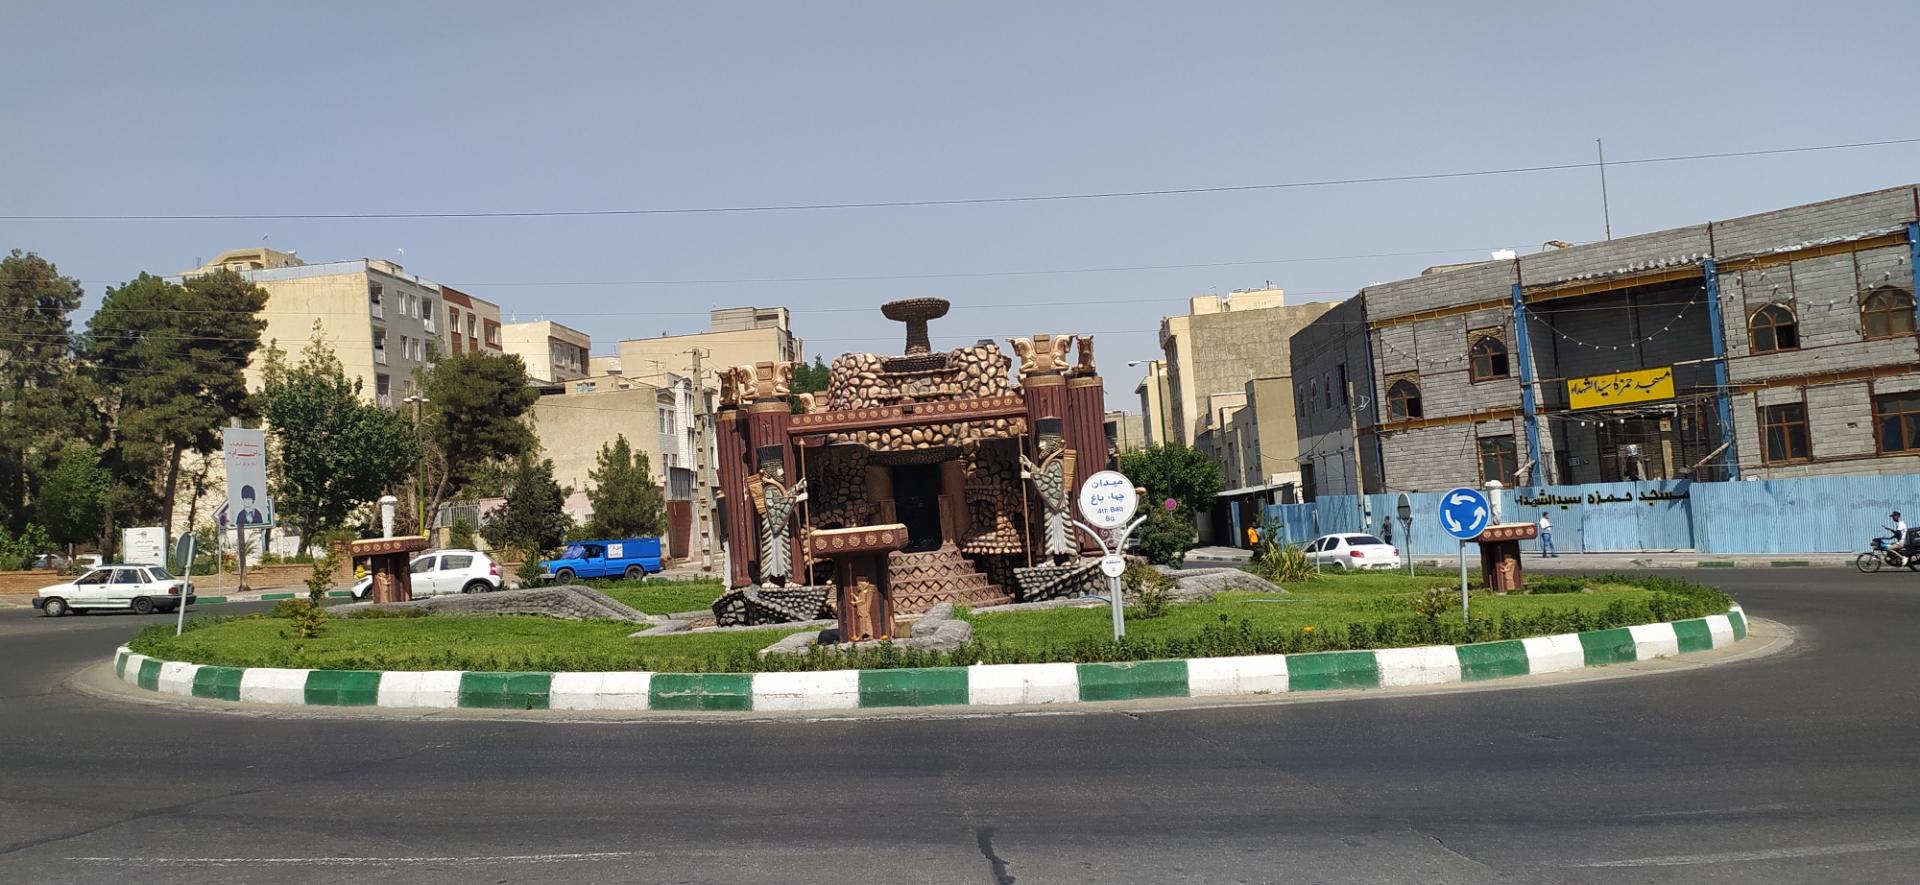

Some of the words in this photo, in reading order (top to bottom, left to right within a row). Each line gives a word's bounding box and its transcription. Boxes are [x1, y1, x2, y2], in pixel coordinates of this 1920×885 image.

[1634, 371, 1670, 394] مسجد
[1091, 480, 1123, 488] میدان
[1090, 494, 1104, 505] باغ
[1587, 490, 1633, 505] حمزه
[1638, 488, 1690, 507] مسجد
